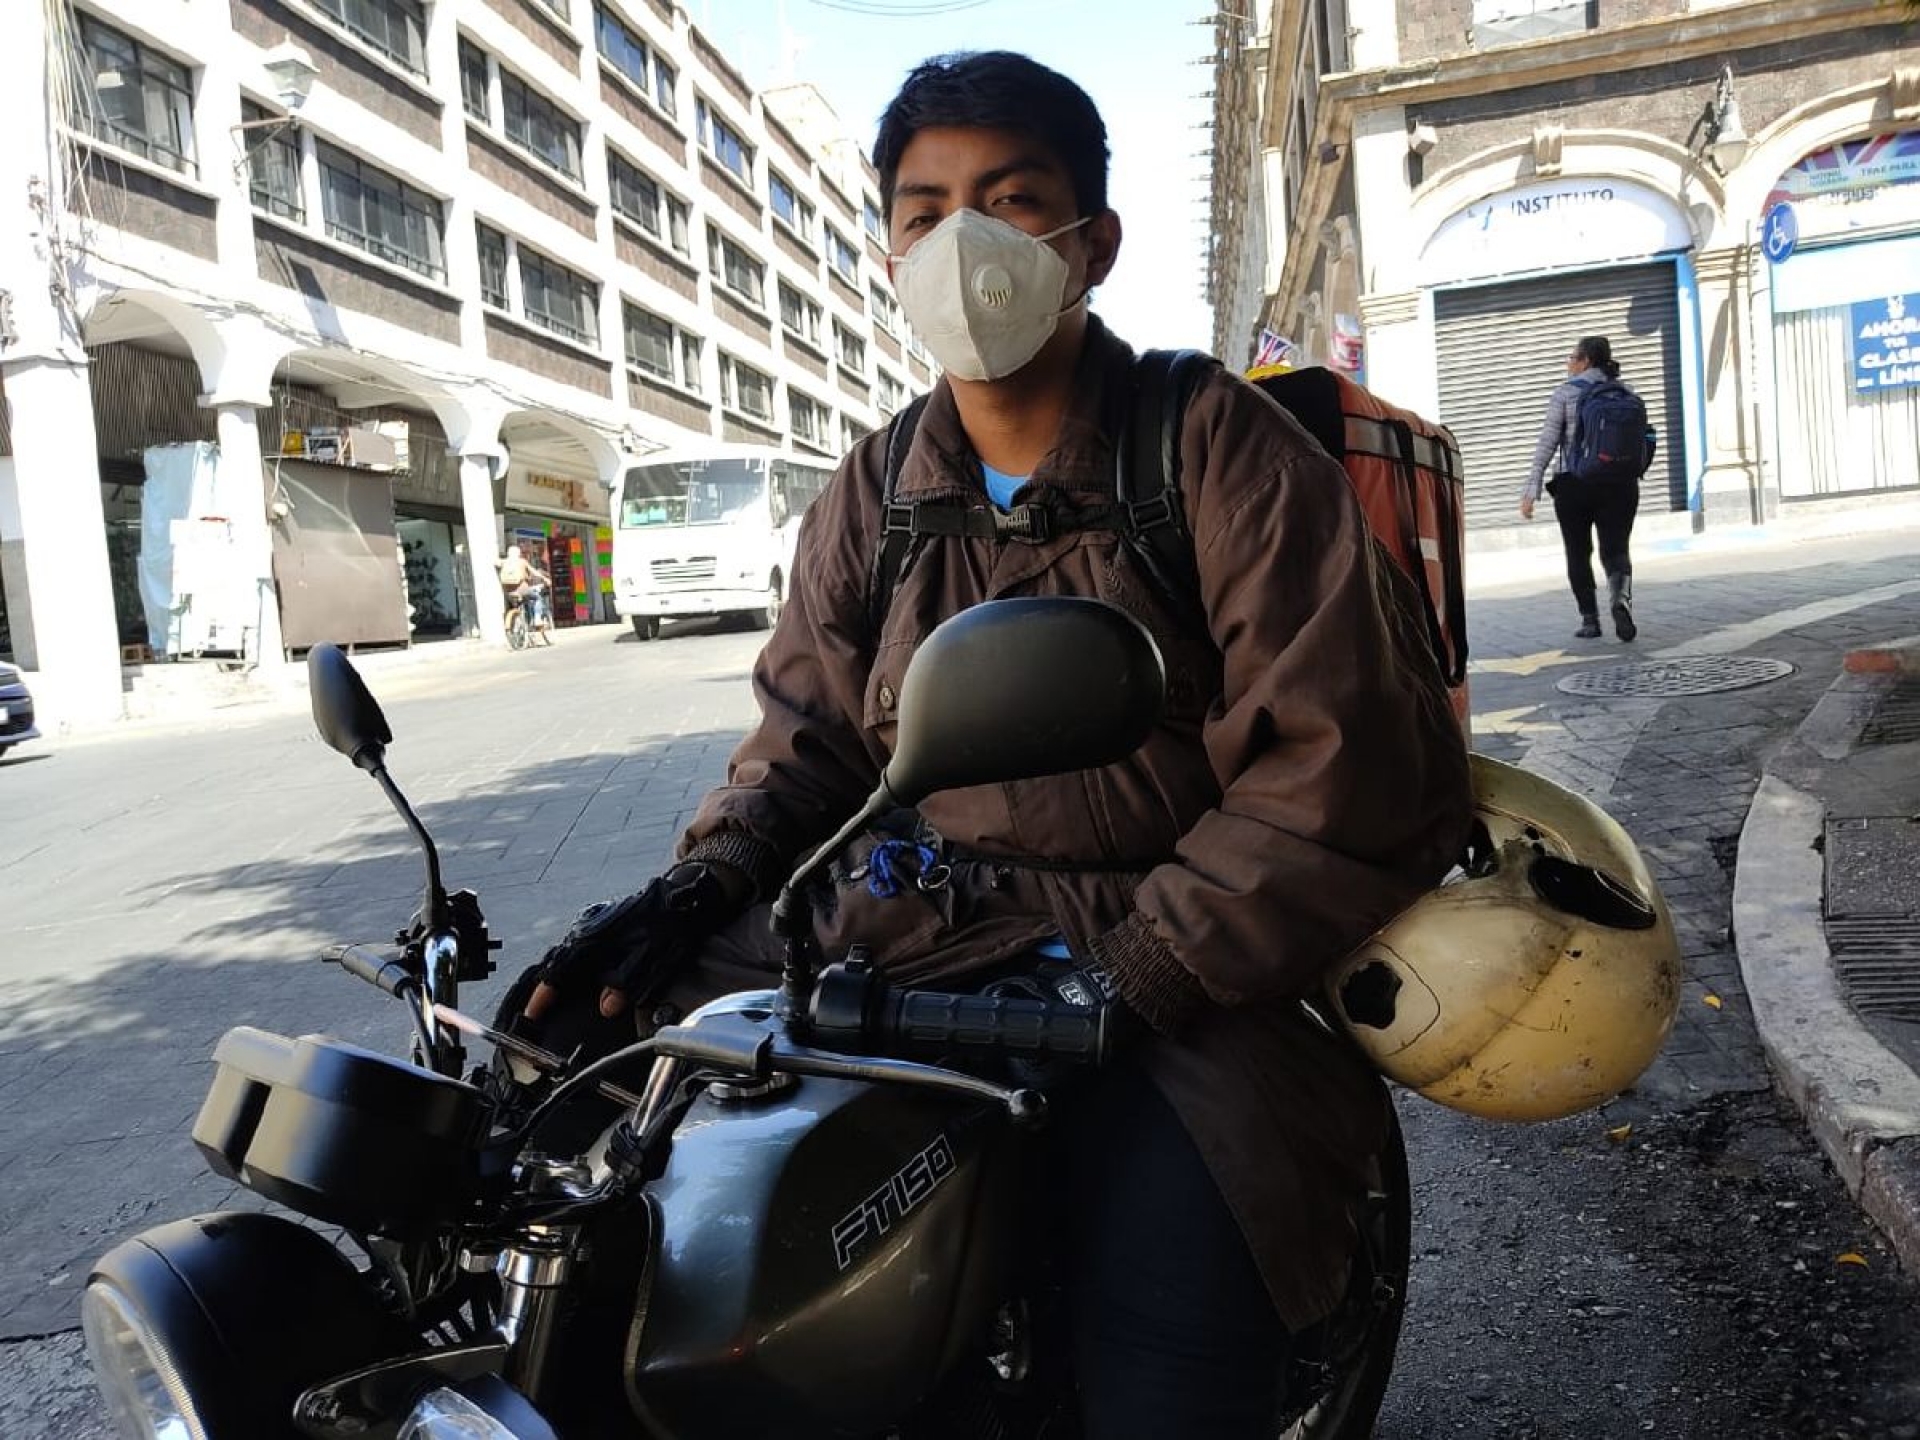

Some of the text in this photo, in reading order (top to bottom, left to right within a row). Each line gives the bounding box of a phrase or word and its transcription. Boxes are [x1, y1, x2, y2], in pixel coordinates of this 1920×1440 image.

[1511, 188, 1614, 217] INSTITUTO
[1859, 317, 1920, 338] AHOR
[831, 1132, 957, 1272] FT150
